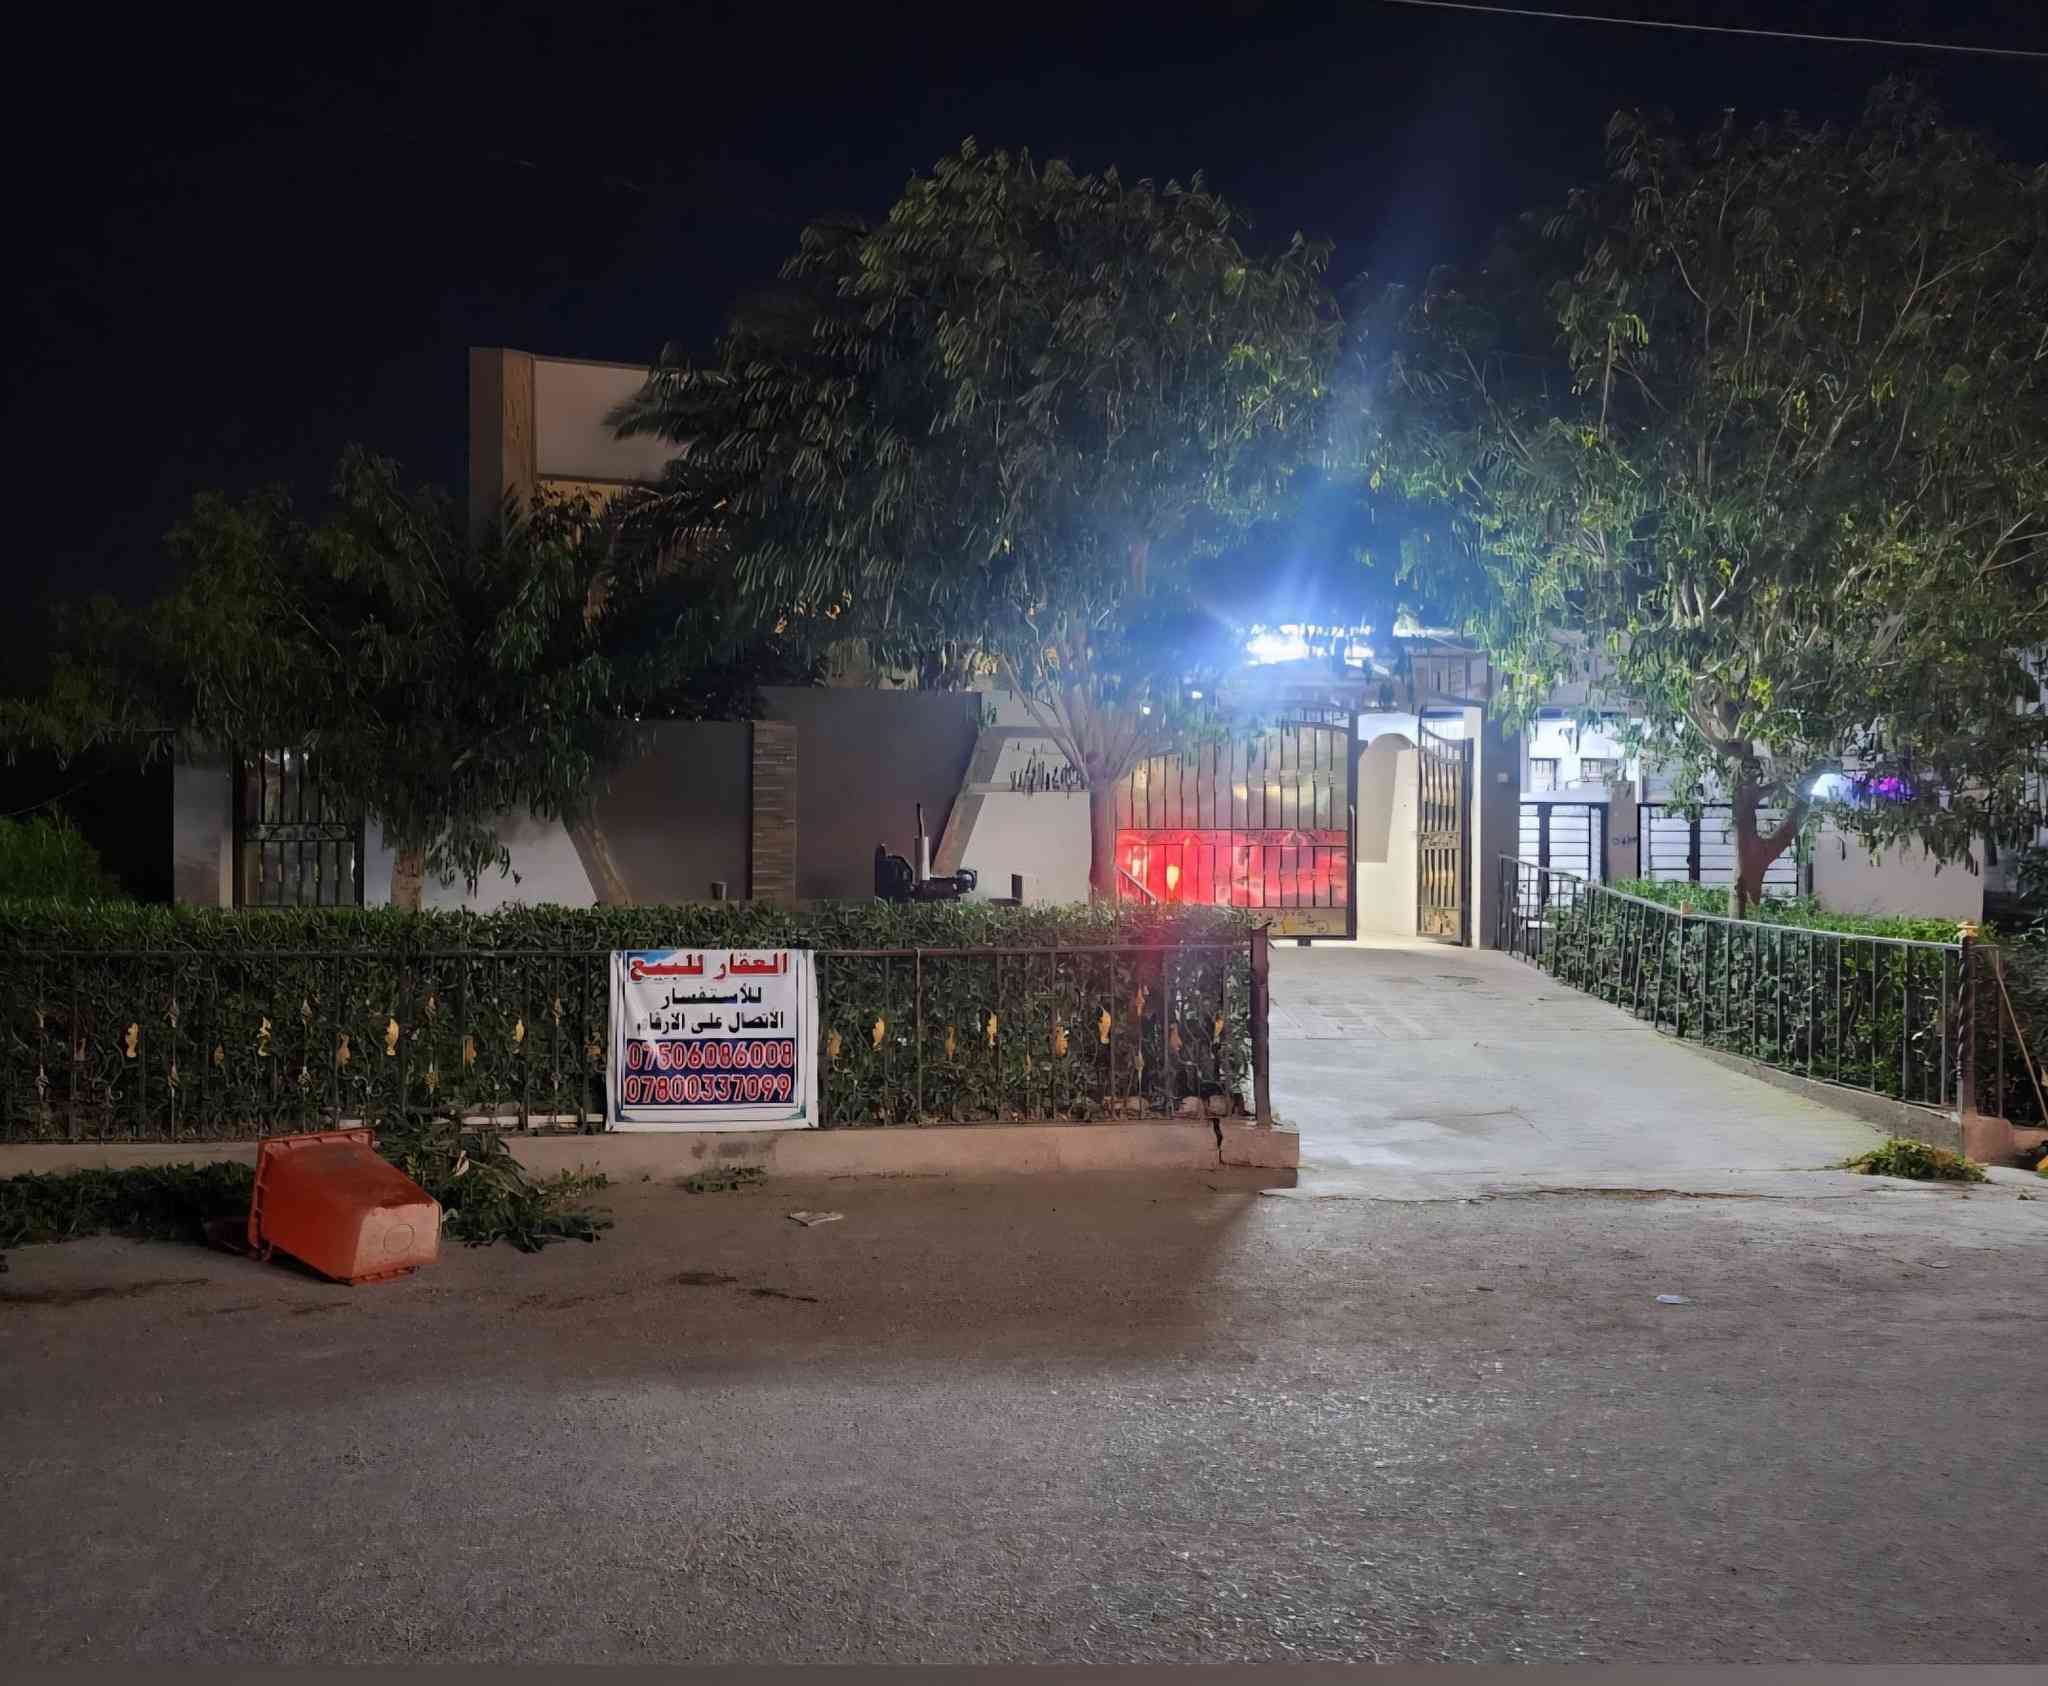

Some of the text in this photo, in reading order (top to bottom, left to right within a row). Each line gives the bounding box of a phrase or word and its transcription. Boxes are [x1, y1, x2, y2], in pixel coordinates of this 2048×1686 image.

[630, 952, 788, 981] العقار للبيع
[691, 1012, 722, 1034] على
[628, 1041, 794, 1070] 07506086008
[625, 1073, 792, 1104] 07800337099
